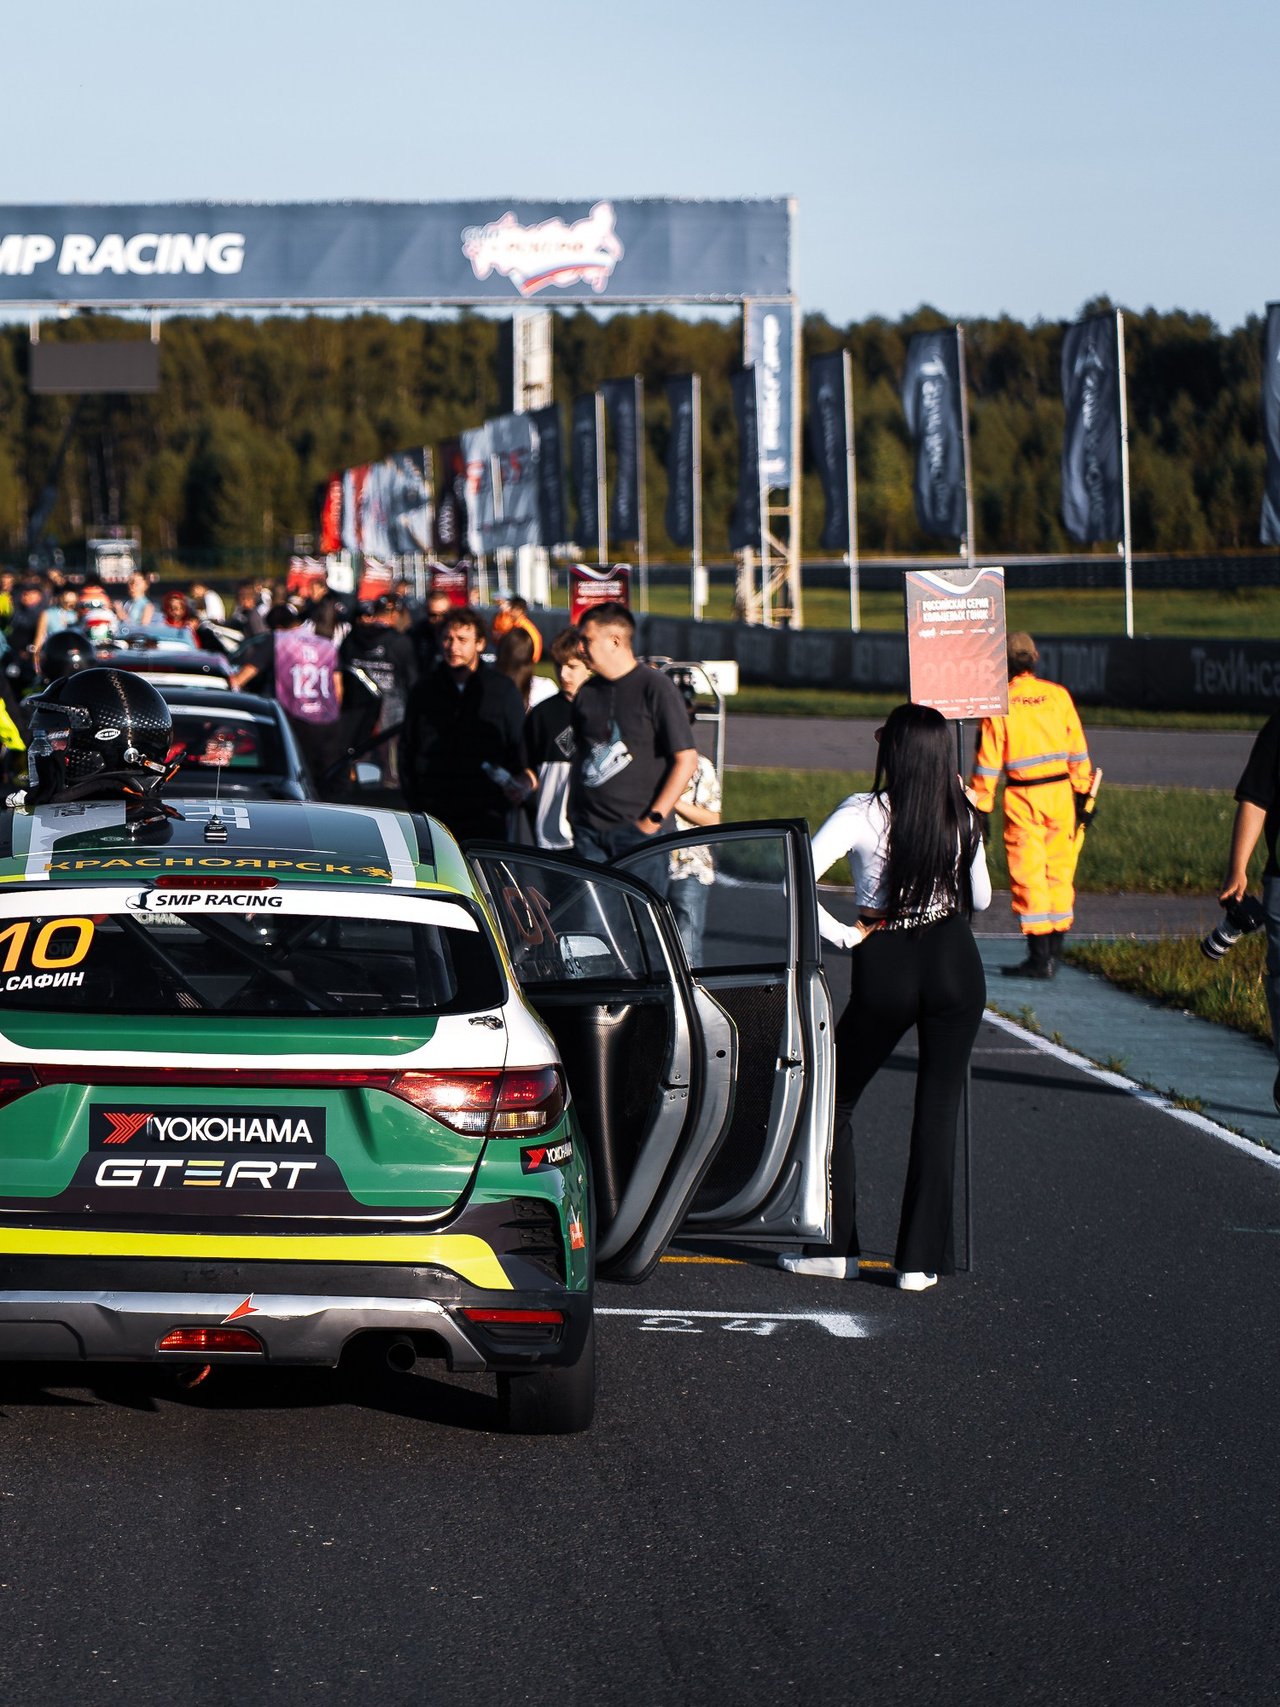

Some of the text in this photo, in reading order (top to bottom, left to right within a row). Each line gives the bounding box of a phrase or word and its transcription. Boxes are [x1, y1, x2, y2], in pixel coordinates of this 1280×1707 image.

[56, 232, 246, 275] RACING
[290, 663, 330, 699] 121
[44, 857, 353, 875] КРАСНОЯРСК
[155, 894, 283, 908] SMP RACING
[153, 1116, 314, 1144] YOKOHAMA
